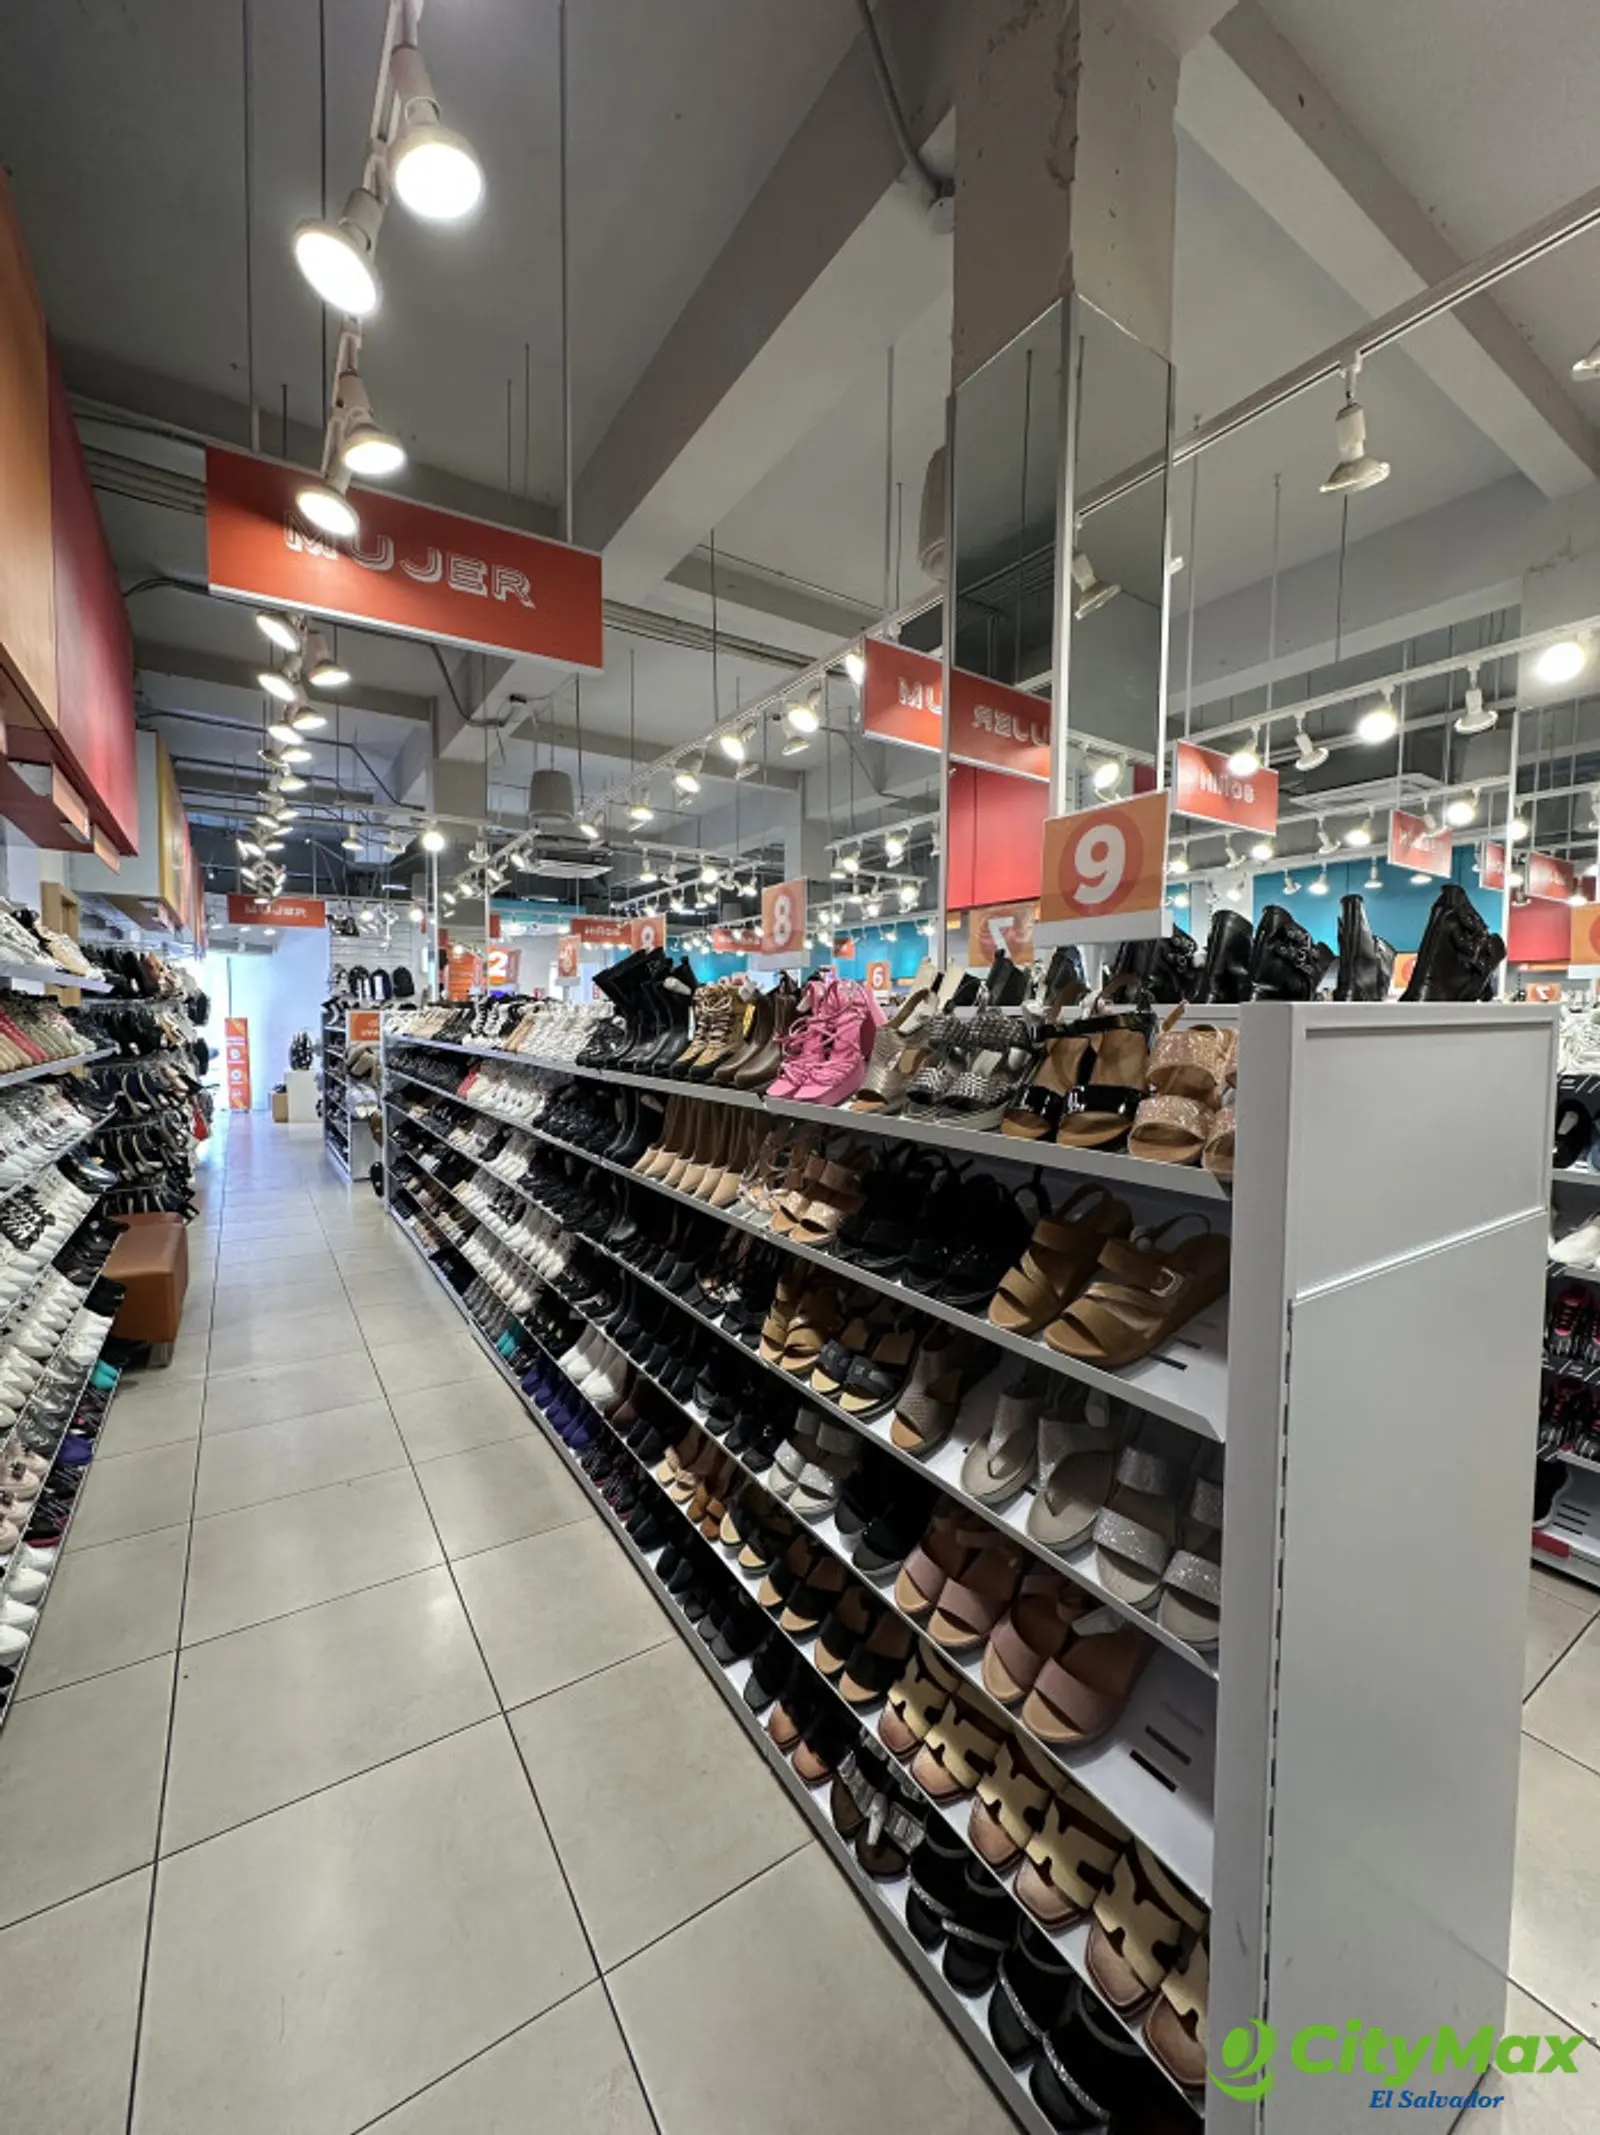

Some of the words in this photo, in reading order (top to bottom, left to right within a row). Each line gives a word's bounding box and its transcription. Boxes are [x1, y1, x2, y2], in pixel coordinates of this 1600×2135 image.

[283, 508, 536, 609] MUJER
[1072, 824, 1126, 905] 9
[772, 894, 793, 946] 8
[488, 951, 509, 977] 2
[872, 966, 884, 987] 6
